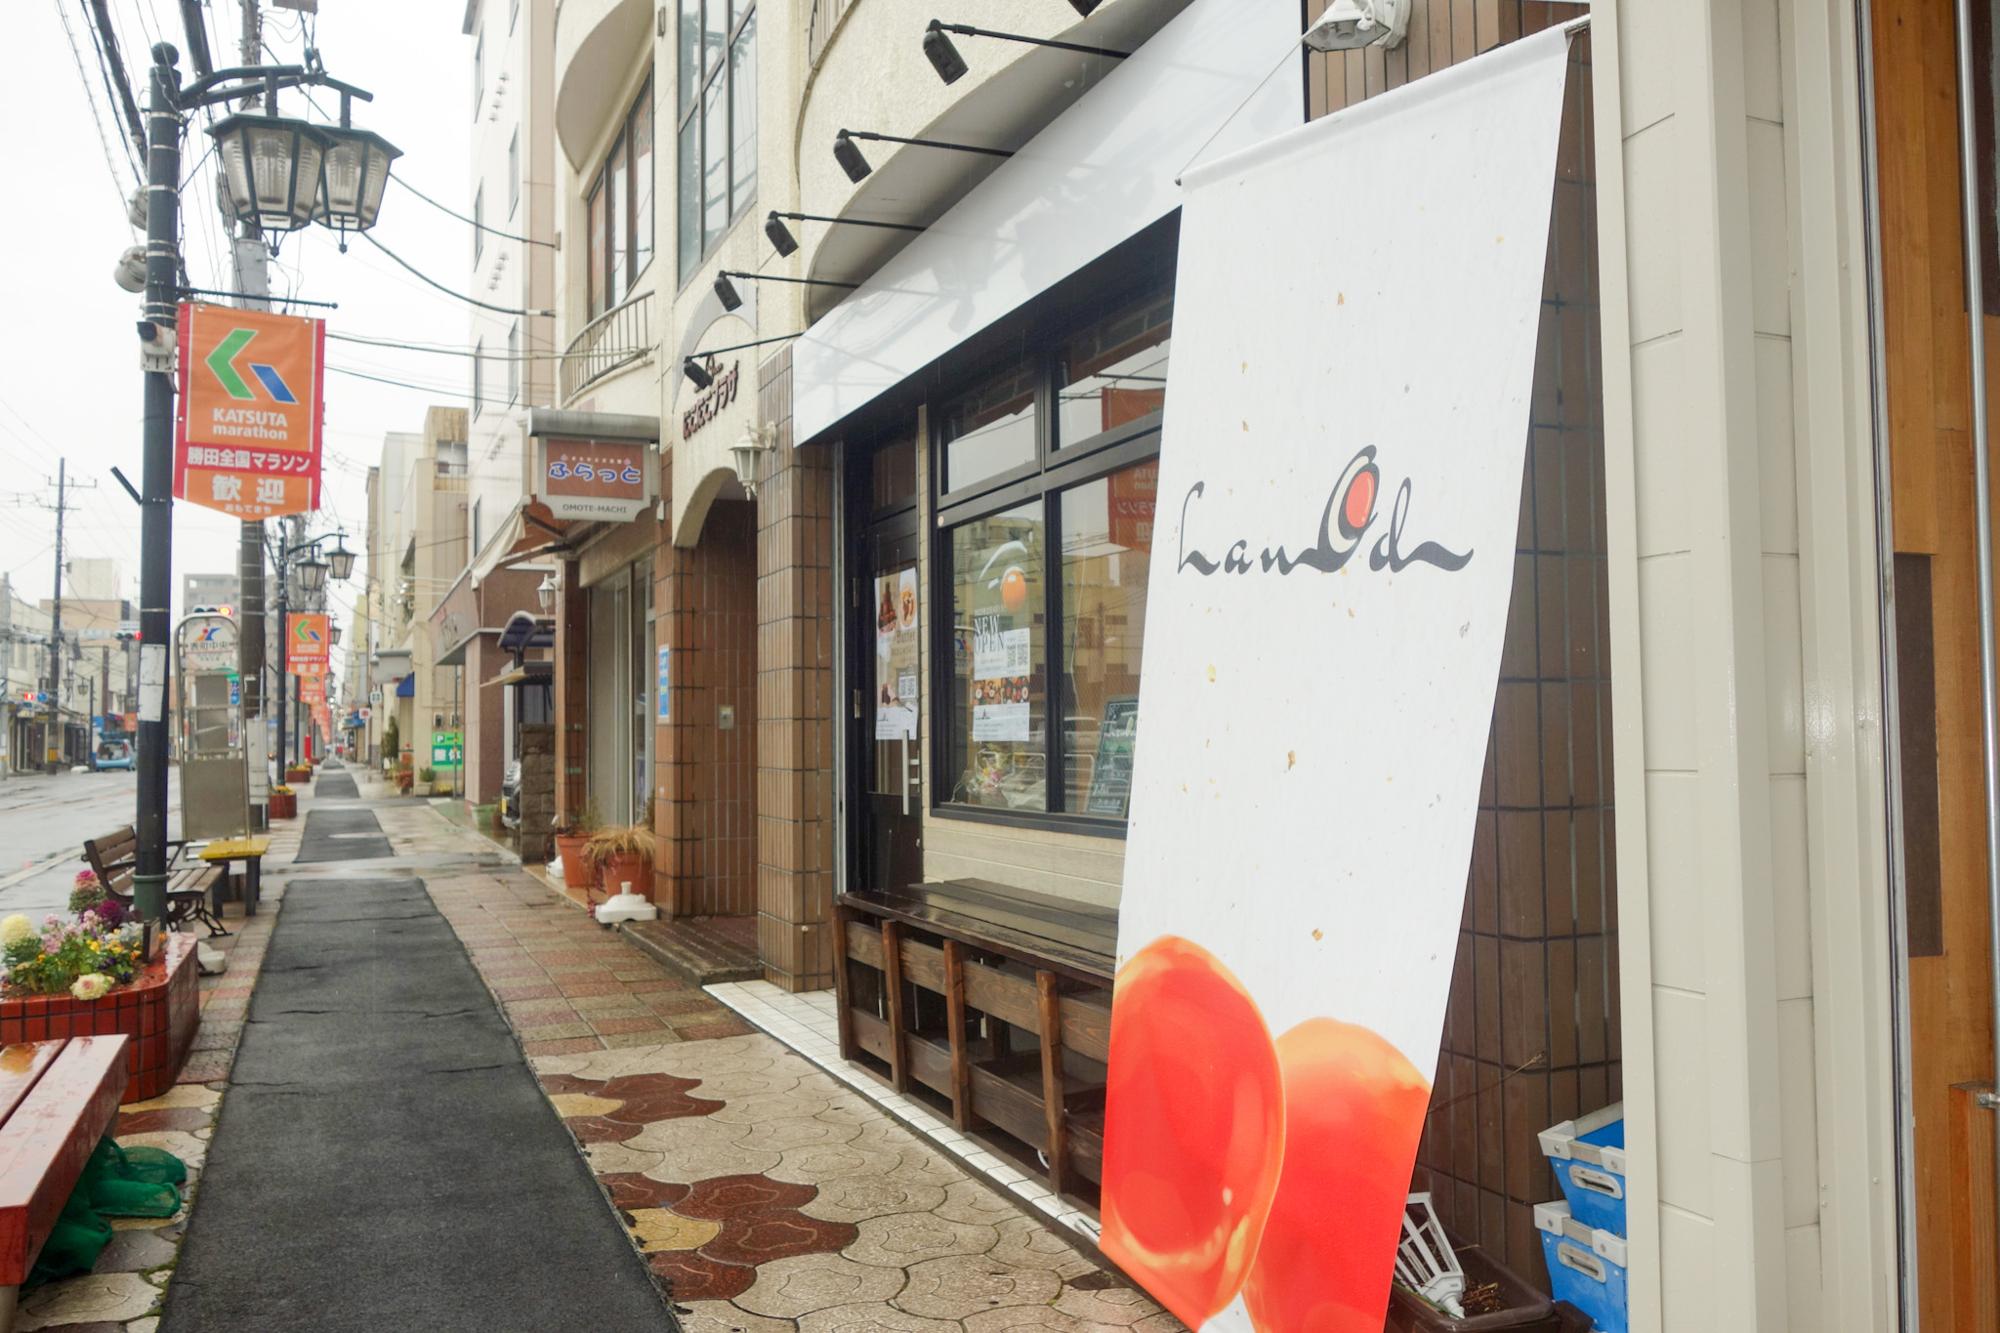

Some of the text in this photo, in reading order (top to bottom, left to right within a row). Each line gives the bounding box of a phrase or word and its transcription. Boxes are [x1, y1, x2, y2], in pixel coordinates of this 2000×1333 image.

[212, 407, 288, 428] KATSUTA
[212, 423, 288, 440] marathon
[187, 446, 311, 473] 勝田全国マラソン
[549, 461, 641, 484] ふらっと
[562, 503, 627, 514] OMOTE-MACHI
[974, 613, 1000, 636] NEW
[975, 632, 1004, 655] OPEN
